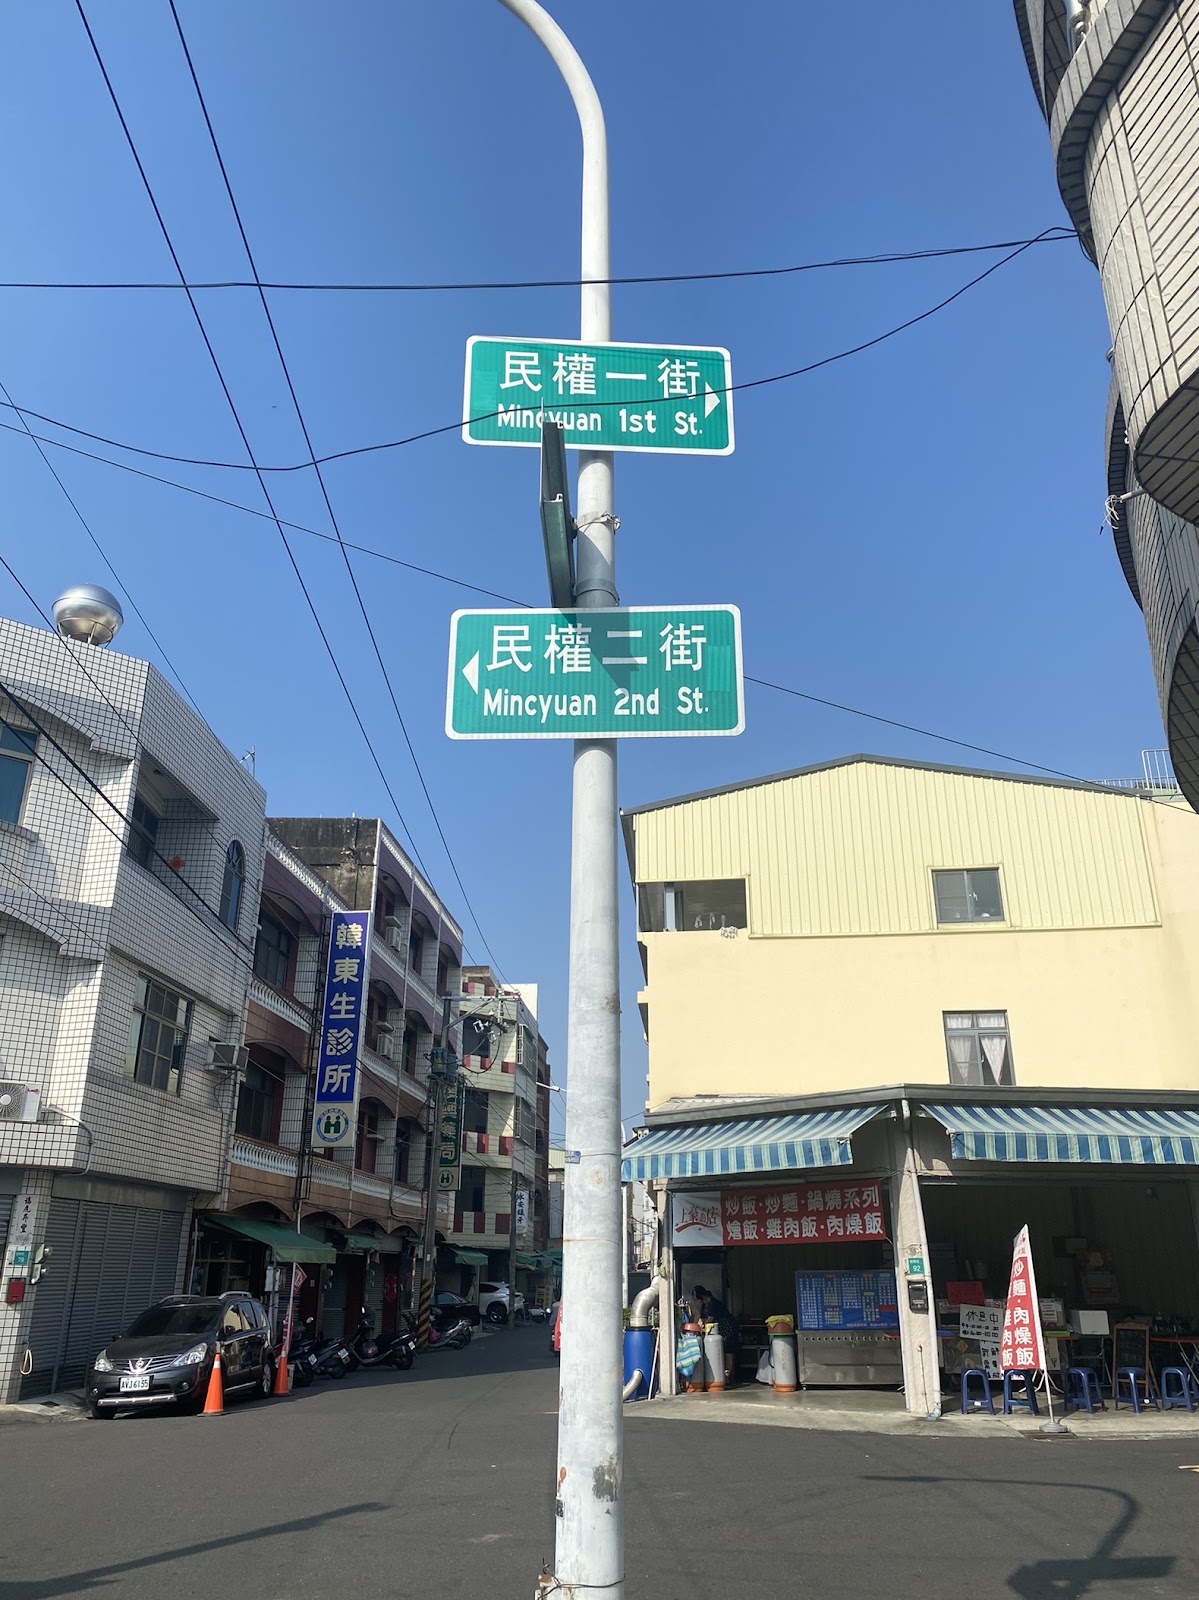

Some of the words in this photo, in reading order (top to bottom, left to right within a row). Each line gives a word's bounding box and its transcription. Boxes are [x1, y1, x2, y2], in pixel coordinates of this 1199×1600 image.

[499, 351, 700, 400] 民權一街
[619, 408, 657, 433] 1st
[674, 411, 703, 435] St.
[485, 622, 707, 674] 民權二街
[483, 689, 596, 723] Mincyuan
[614, 688, 659, 715] 2nd
[677, 687, 708, 715] St.
[321, 922, 364, 1094] 韓東生診所
[912, 1264, 921, 1272] 92
[965, 1310, 999, 1324] 休息中
